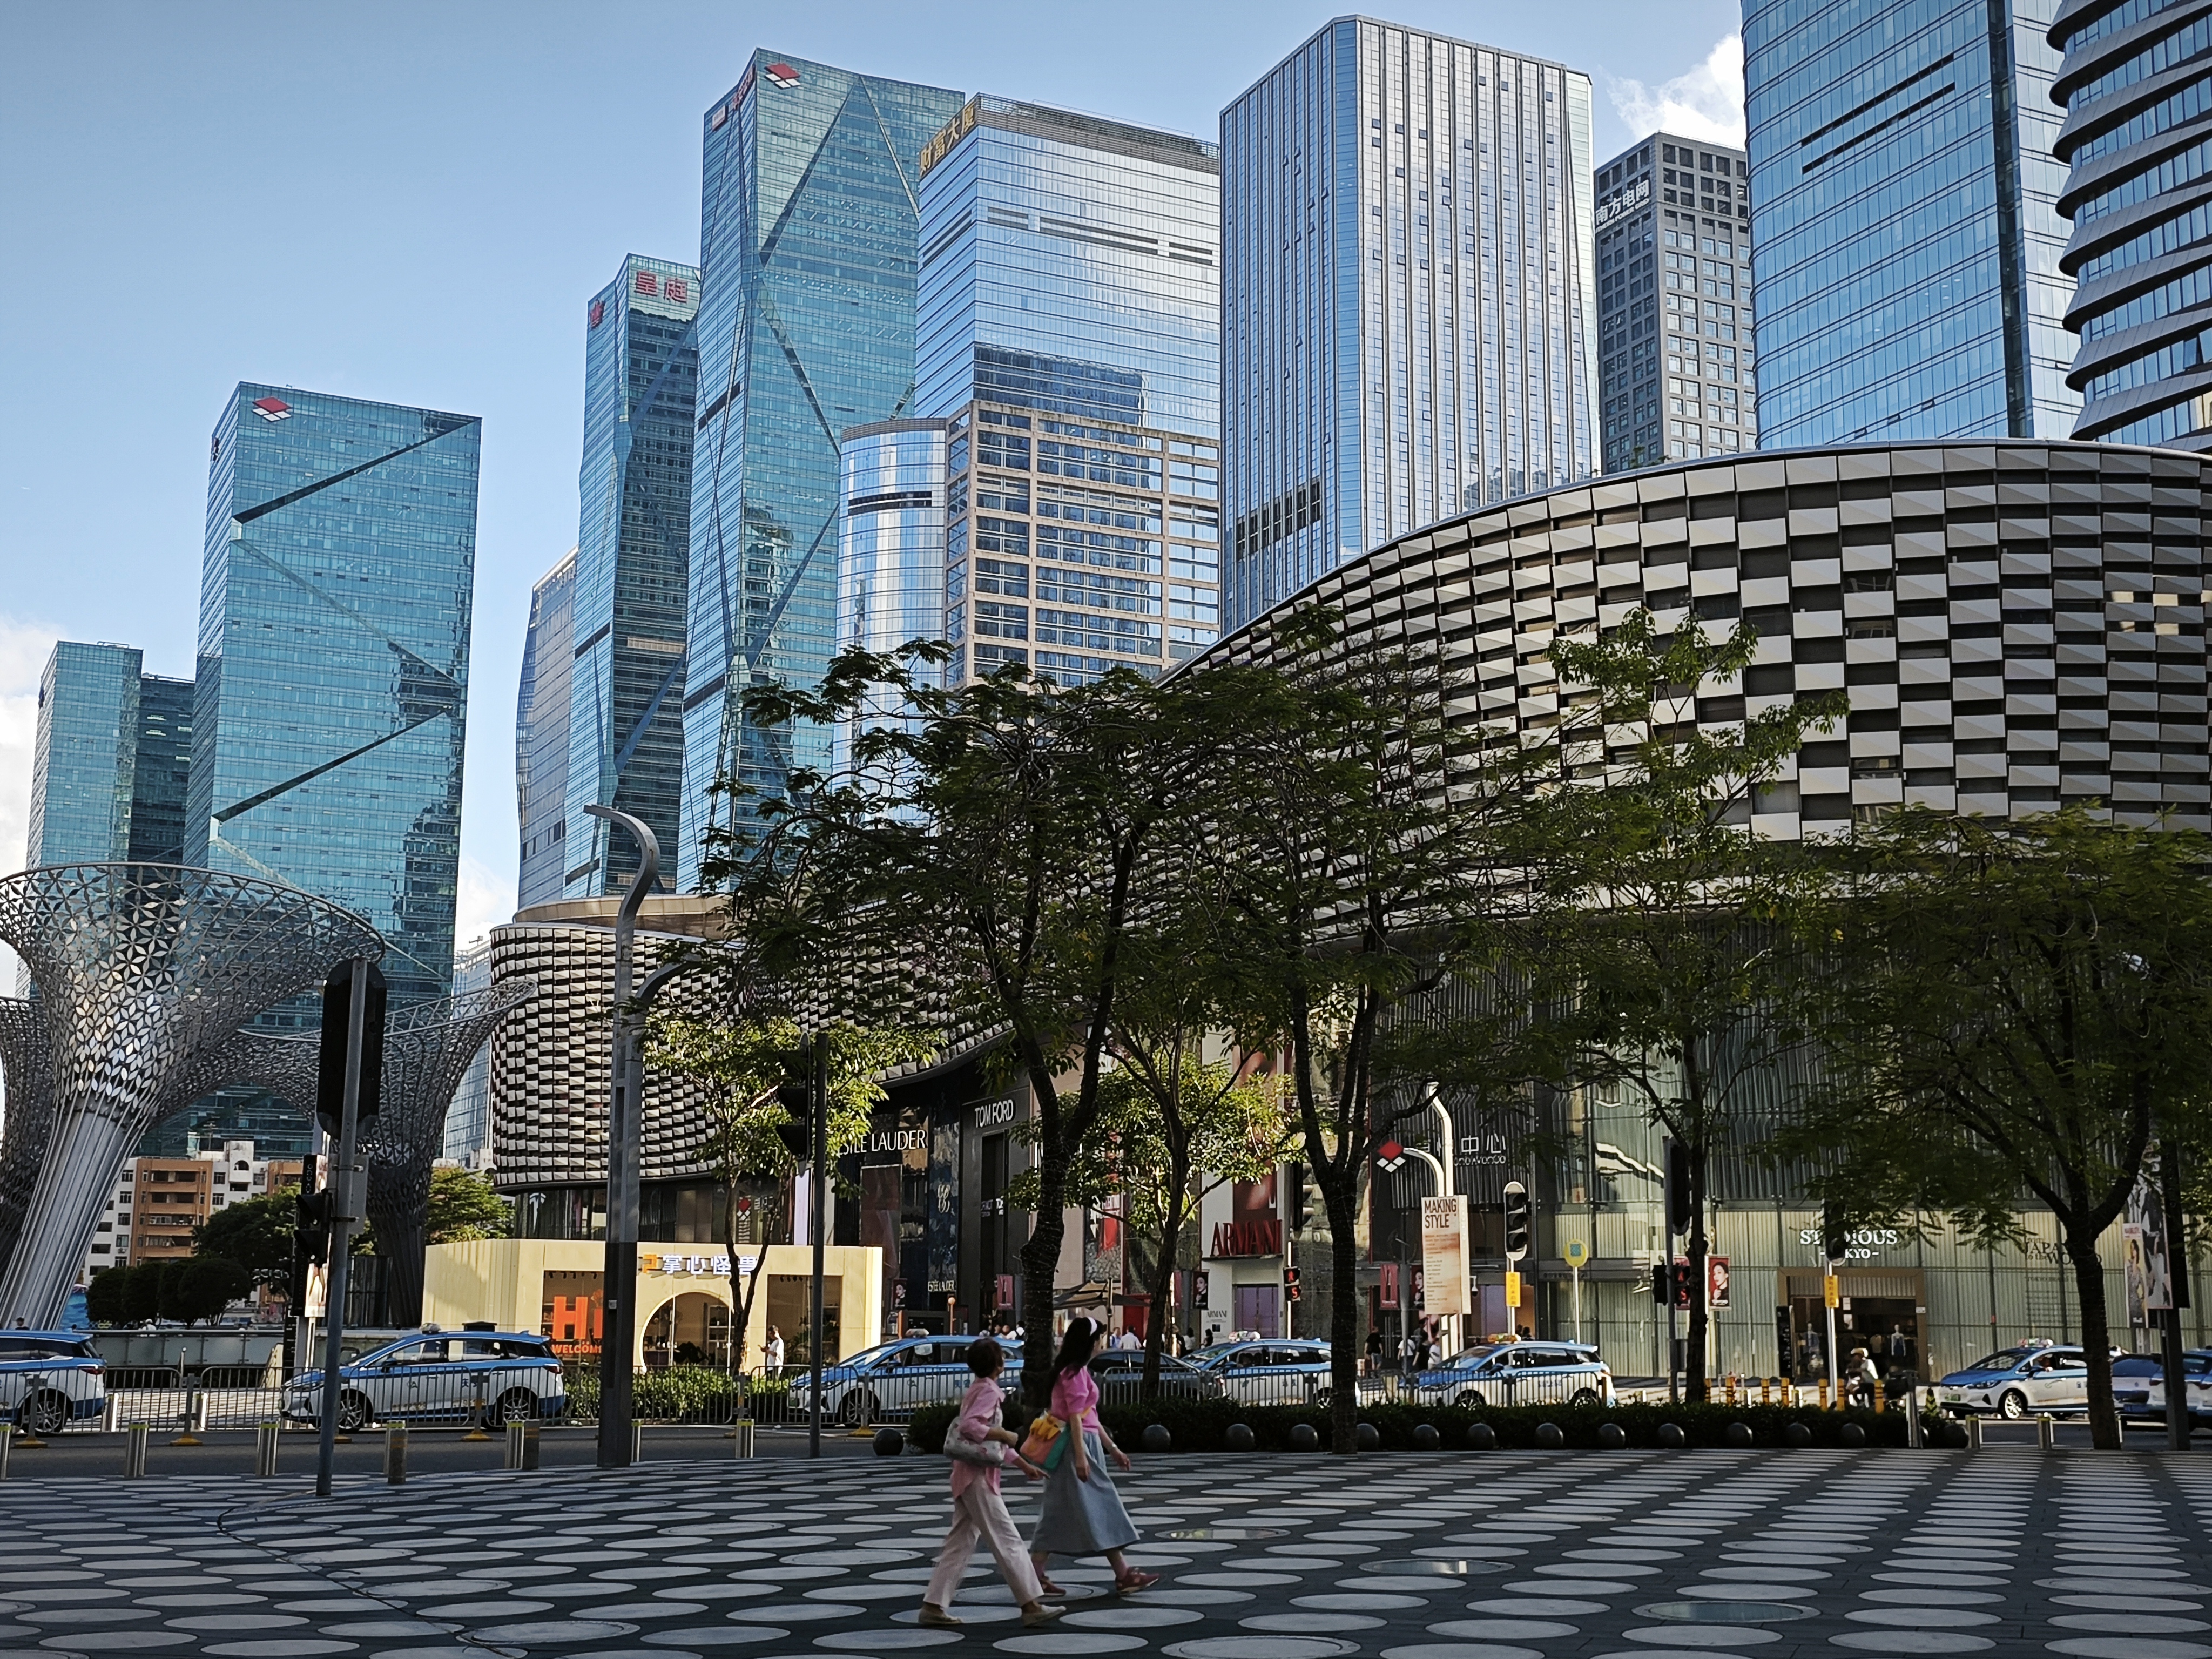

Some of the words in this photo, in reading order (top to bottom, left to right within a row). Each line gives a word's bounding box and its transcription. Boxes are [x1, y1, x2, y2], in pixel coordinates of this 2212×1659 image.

[1595, 179, 1649, 226] 南方电网
[634, 271, 687, 304] 皇庭
[975, 1104, 991, 1128] TOM
[992, 1099, 1014, 1124] FORD
[871, 1129, 926, 1152] LAUDER
[1424, 1198, 1456, 1213] MAKING
[1425, 1214, 1449, 1229] STYLE
[1210, 1219, 1282, 1257] ARMANI
[662, 1255, 757, 1276] 掌心怪兽
